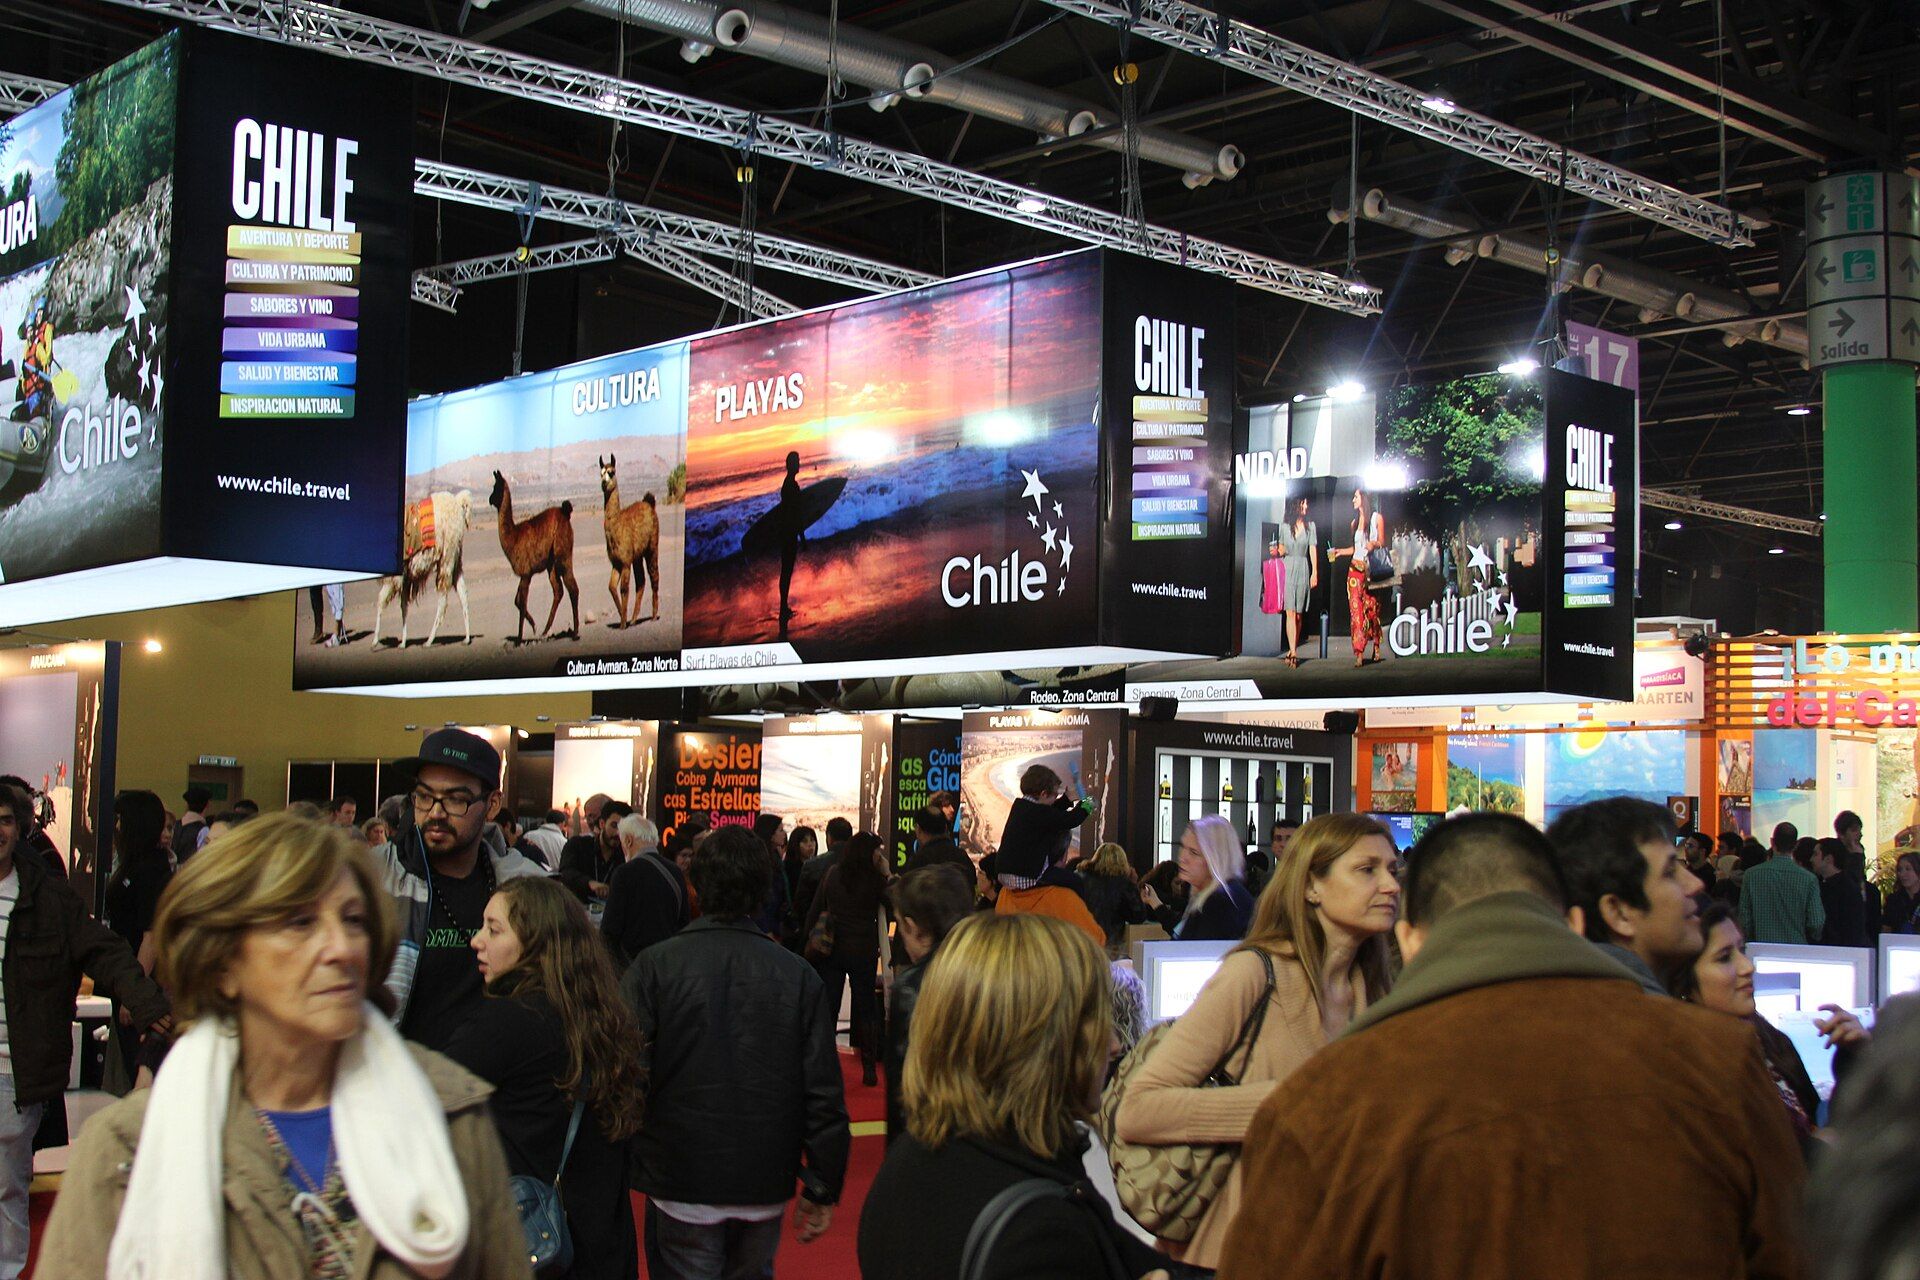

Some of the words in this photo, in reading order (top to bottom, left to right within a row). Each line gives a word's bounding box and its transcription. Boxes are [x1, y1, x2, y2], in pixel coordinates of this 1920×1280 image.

[232, 118, 359, 233] CHILE
[0, 194, 38, 255] URA
[240, 230, 293, 247] AVENTURA
[295, 233, 303, 248] Y
[304, 234, 349, 250] DEPORTE
[232, 263, 280, 280] CULTURA
[281, 265, 289, 280] Y
[290, 265, 353, 282] PATRIMONIO
[250, 297, 298, 314] SABORES
[299, 299, 308, 314] Y
[308, 299, 333, 314] VINO
[258, 332, 283, 348] VIDA
[284, 332, 326, 348] URBANA
[1569, 334, 1579, 356] LE
[1134, 315, 1205, 398] CHILE
[1821, 341, 1869, 360] Salida
[1584, 335, 1629, 387] 17
[238, 365, 272, 381] SALUD
[274, 366, 282, 381] Y
[283, 366, 339, 382] BIENESTAR
[572, 368, 661, 417] CULTURA
[715, 372, 804, 423] PLAYAS
[230, 398, 296, 414] INSPIRACION
[297, 398, 344, 414] NATURAL
[60, 393, 142, 475] Chile
[1147, 449, 1174, 461] SABORES
[1566, 423, 1613, 492] CHILE
[1235, 448, 1307, 485] NIDAD
[217, 474, 350, 501] www.chile.travel
[942, 549, 1048, 608] Chile
[1132, 582, 1207, 600] www.chile.travel
[1389, 610, 1492, 657] Chile
[1563, 641, 1614, 658] www.chile.travel
[567, 660, 595, 675] Cultura
[631, 657, 652, 673] Zona
[653, 656, 678, 671] Norte
[709, 653, 739, 670] Playas
[740, 651, 753, 668] de
[754, 650, 778, 667] Chile
[1030, 690, 1061, 704] Rodeo,
[1062, 689, 1085, 703] Zona
[1086, 688, 1119, 703] Central
[1180, 686, 1204, 699] Zona
[1206, 685, 1242, 698] Central
[1767, 690, 1837, 727] del
[1855, 689, 1918, 727] Ca
[1263, 719, 1320, 729] SALVADOR
[1203, 730, 1294, 749] www.chile.travel
[679, 735, 763, 770] Desier
[901, 757, 923, 776] as
[676, 770, 707, 787] Cobre
[713, 771, 758, 789] Aymara
[927, 767, 960, 792] Gla
[664, 793, 687, 809] cas
[690, 786, 762, 812] Estrellas
